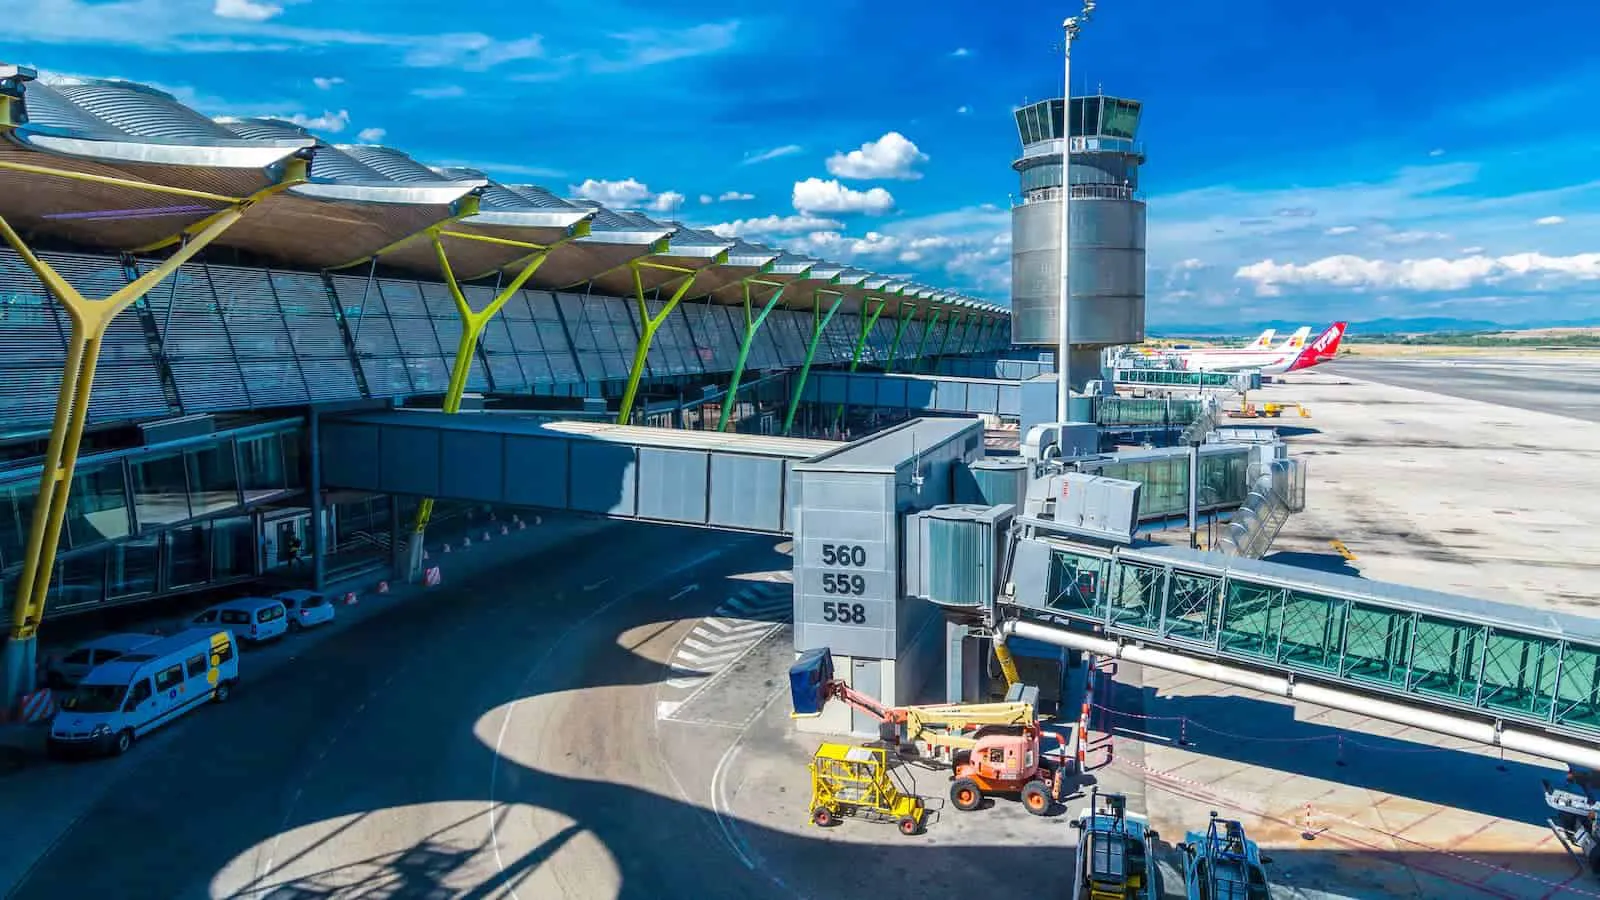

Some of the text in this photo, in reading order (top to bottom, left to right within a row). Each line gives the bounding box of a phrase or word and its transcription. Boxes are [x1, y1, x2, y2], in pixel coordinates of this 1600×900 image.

[822, 543, 867, 568] 560
[822, 573, 866, 596] 559
[823, 601, 866, 625] 558
